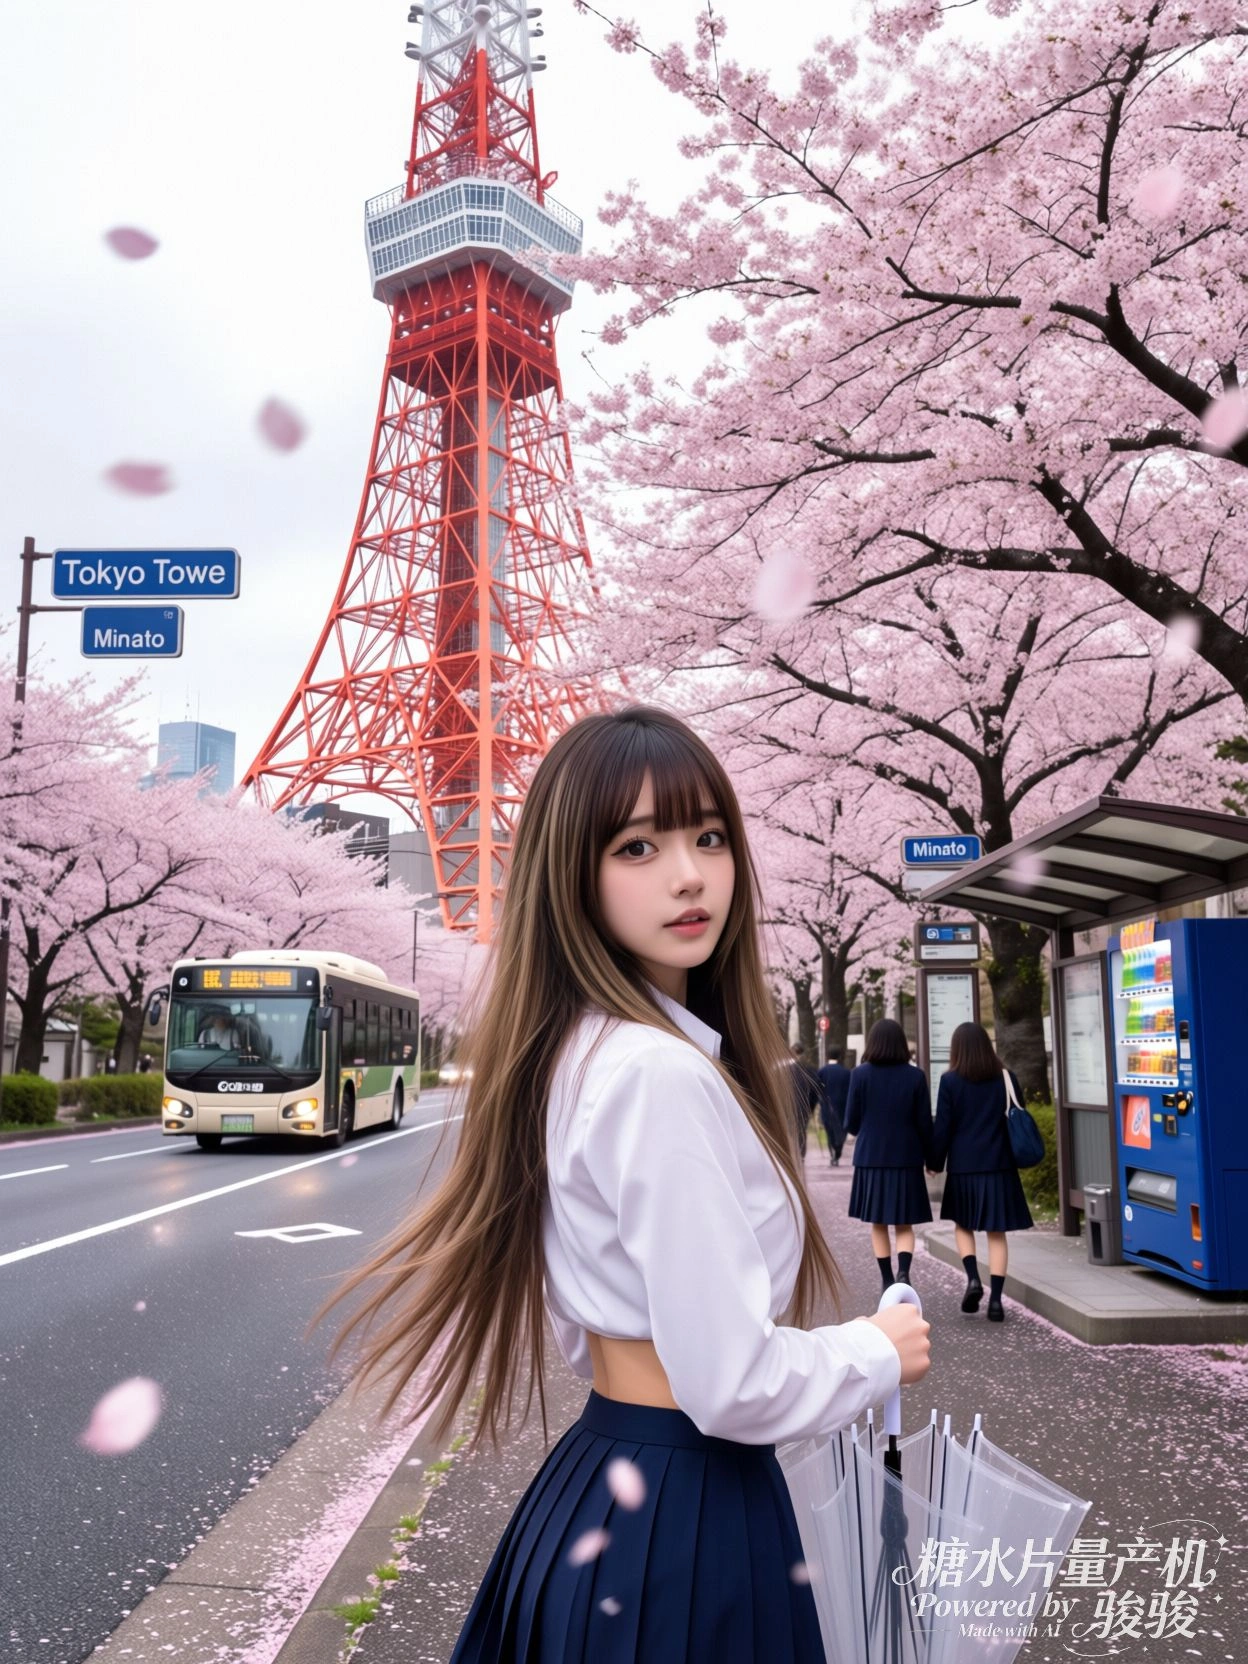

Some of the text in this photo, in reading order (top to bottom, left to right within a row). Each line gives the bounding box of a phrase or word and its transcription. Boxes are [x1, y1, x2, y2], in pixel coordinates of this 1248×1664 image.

[61, 558, 226, 591] Tokyo Towe
[94, 628, 165, 648] Minato
[913, 841, 967, 858] Minato
